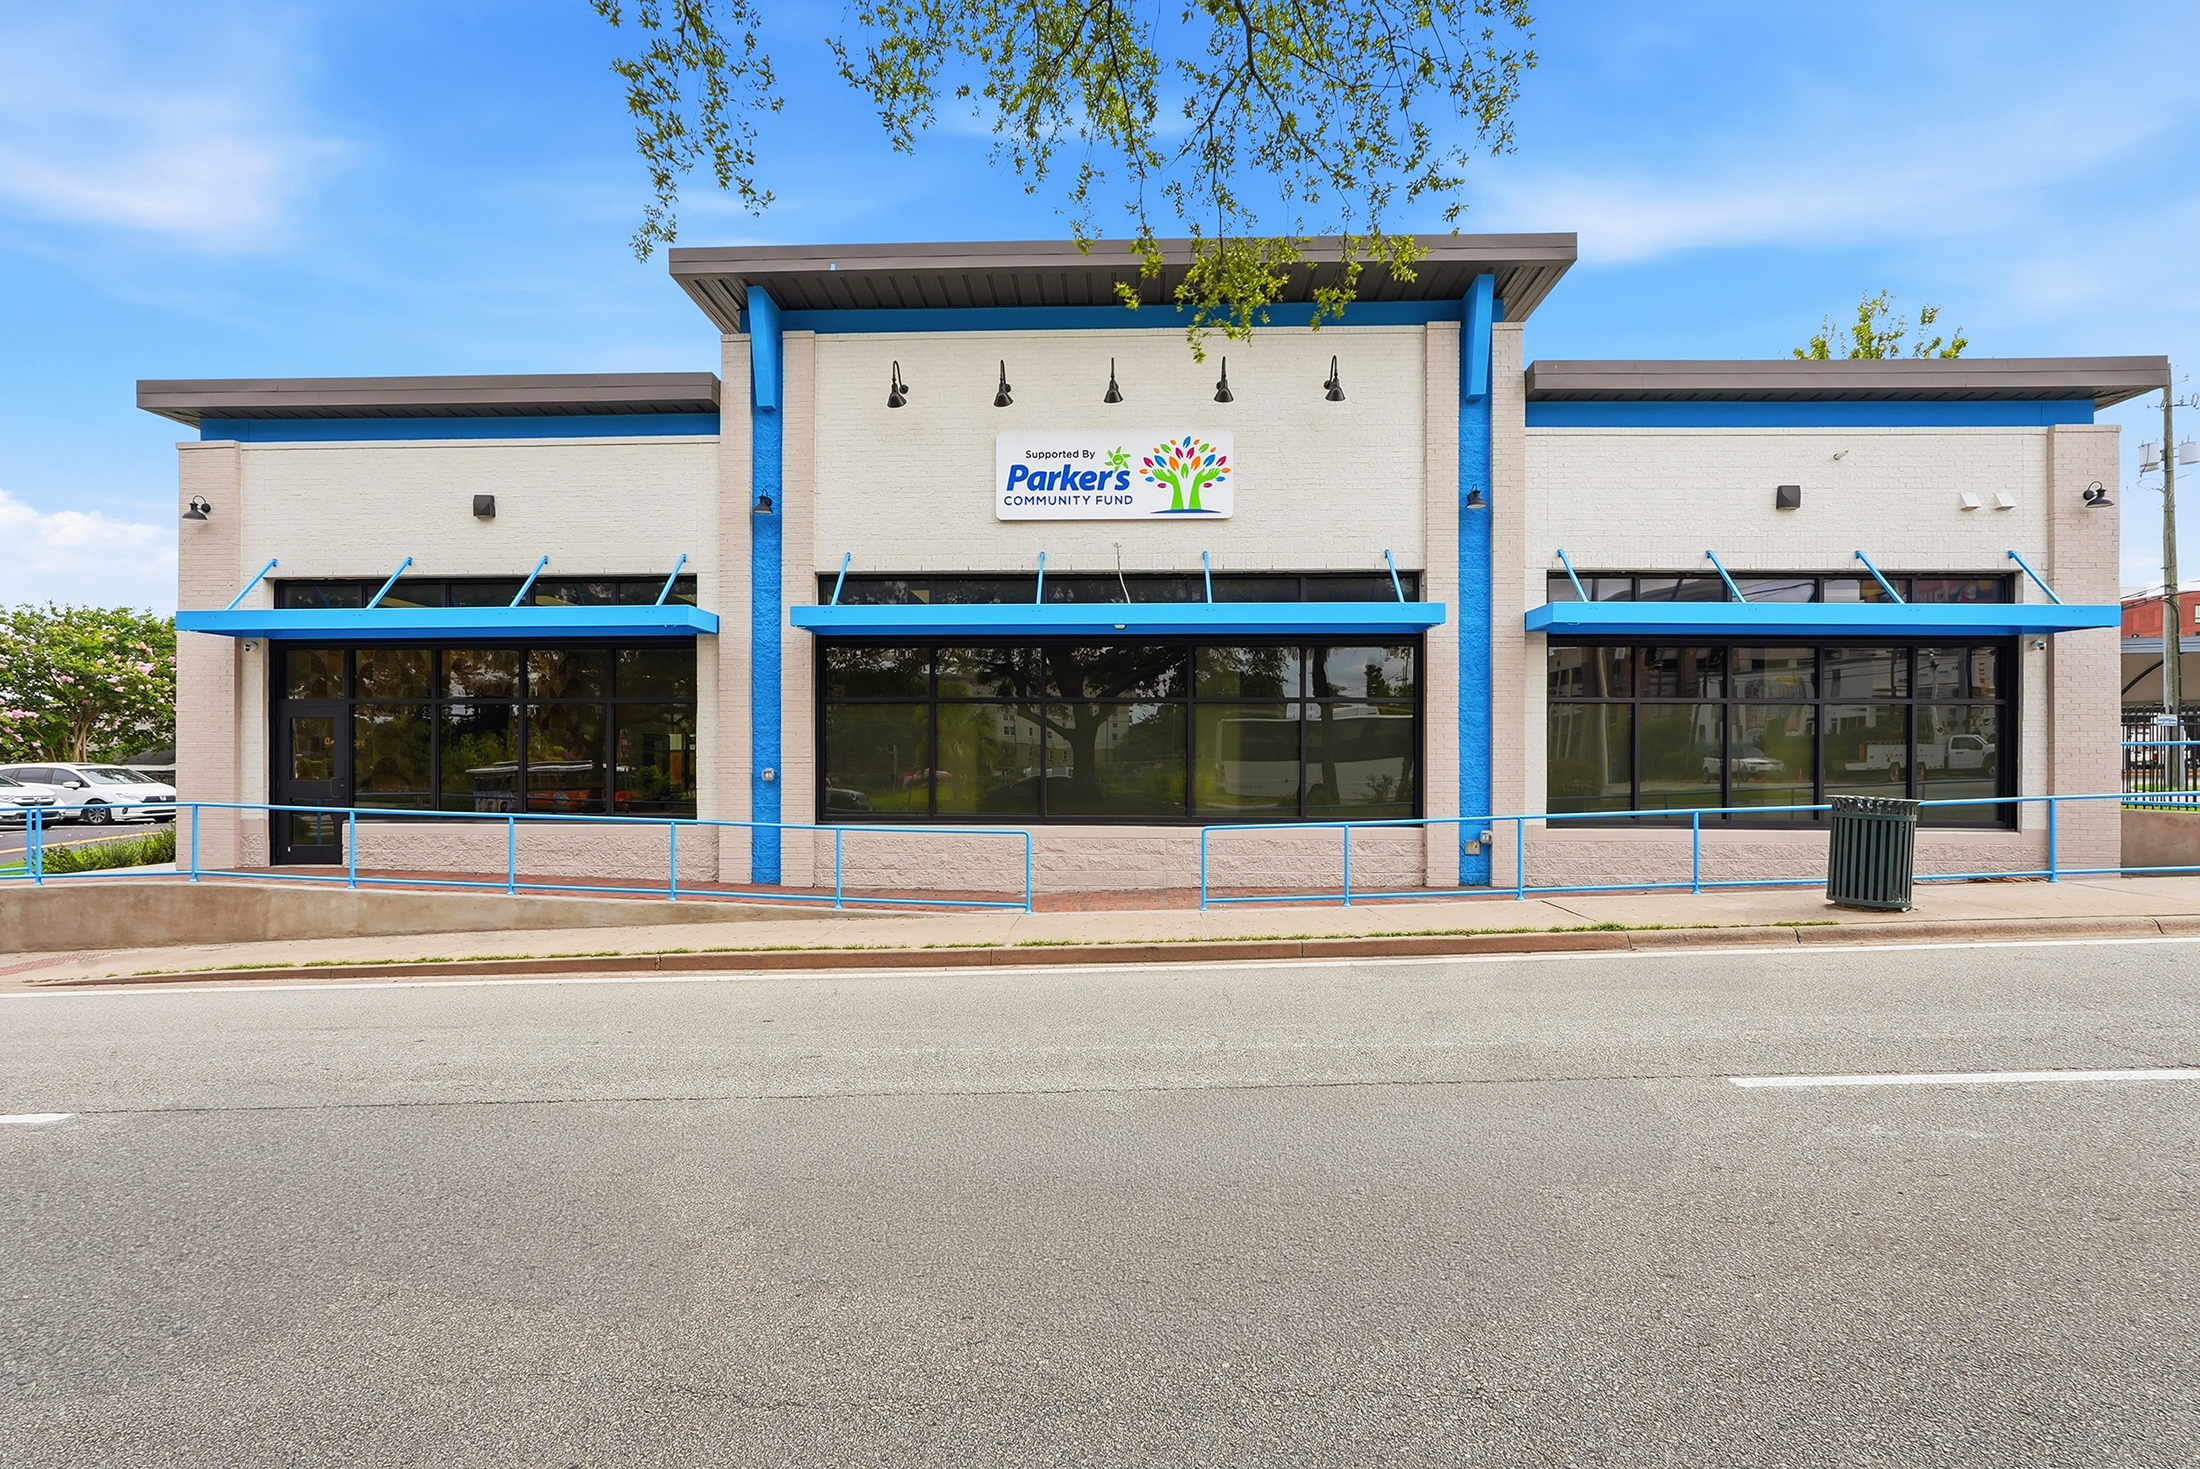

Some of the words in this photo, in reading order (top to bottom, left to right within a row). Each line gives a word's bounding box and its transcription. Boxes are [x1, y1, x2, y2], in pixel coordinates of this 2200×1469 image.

[1025, 449, 1079, 460] Supported
[1082, 449, 1096, 460] By
[1003, 495, 1091, 506] COMMUNITY
[1095, 495, 1133, 506] FUND
